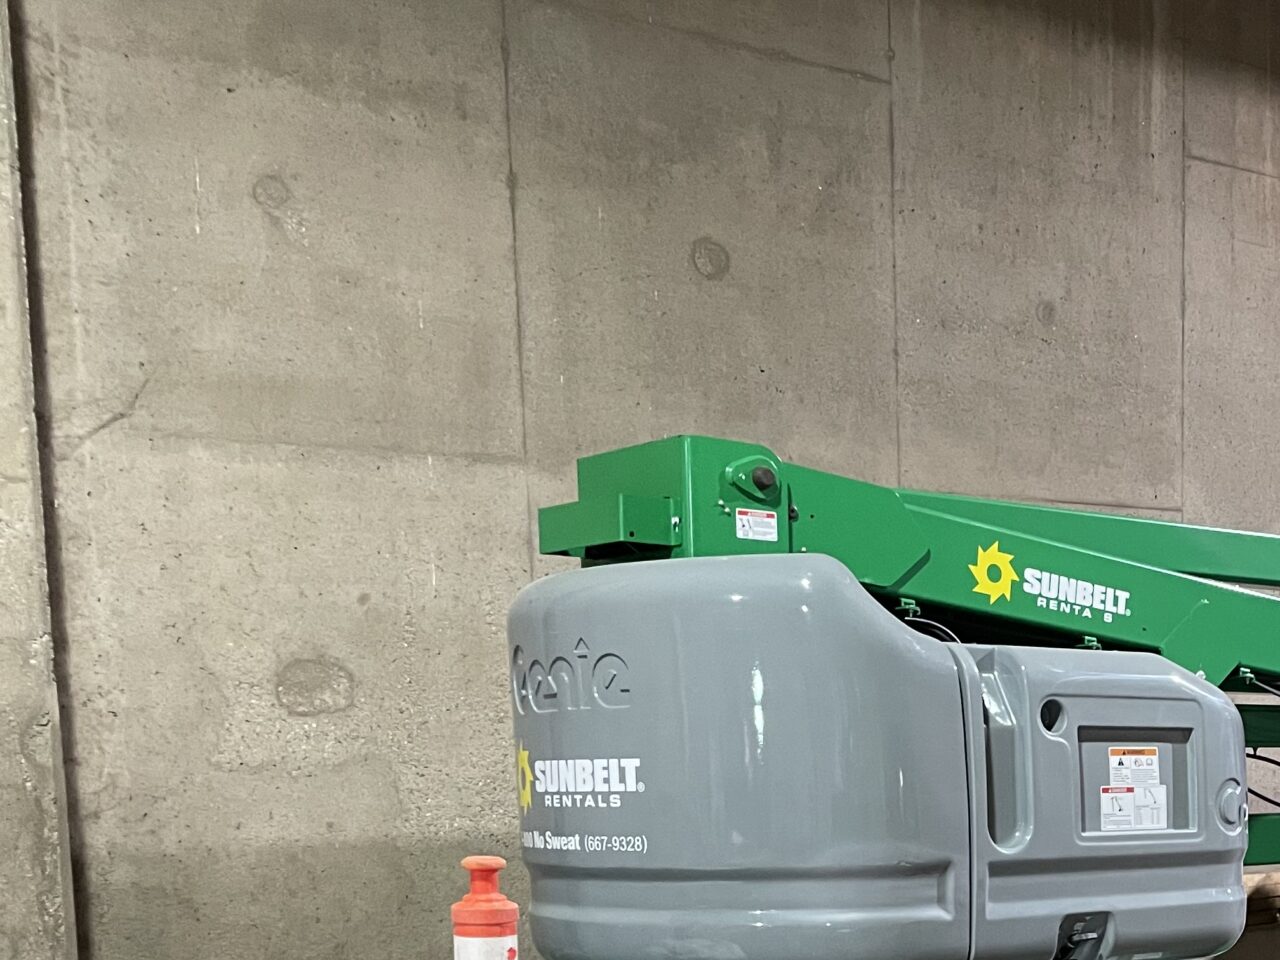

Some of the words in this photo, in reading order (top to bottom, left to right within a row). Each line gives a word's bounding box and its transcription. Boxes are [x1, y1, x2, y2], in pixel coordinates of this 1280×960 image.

[1022, 567, 1131, 616] SUNBELT
[1036, 596, 1113, 623] RENTAS
[534, 758, 645, 793] SUNBELT
[544, 795, 622, 808] RENTALS
[545, 830, 581, 851] Sweat
[584, 834, 648, 854] (667-9328)
